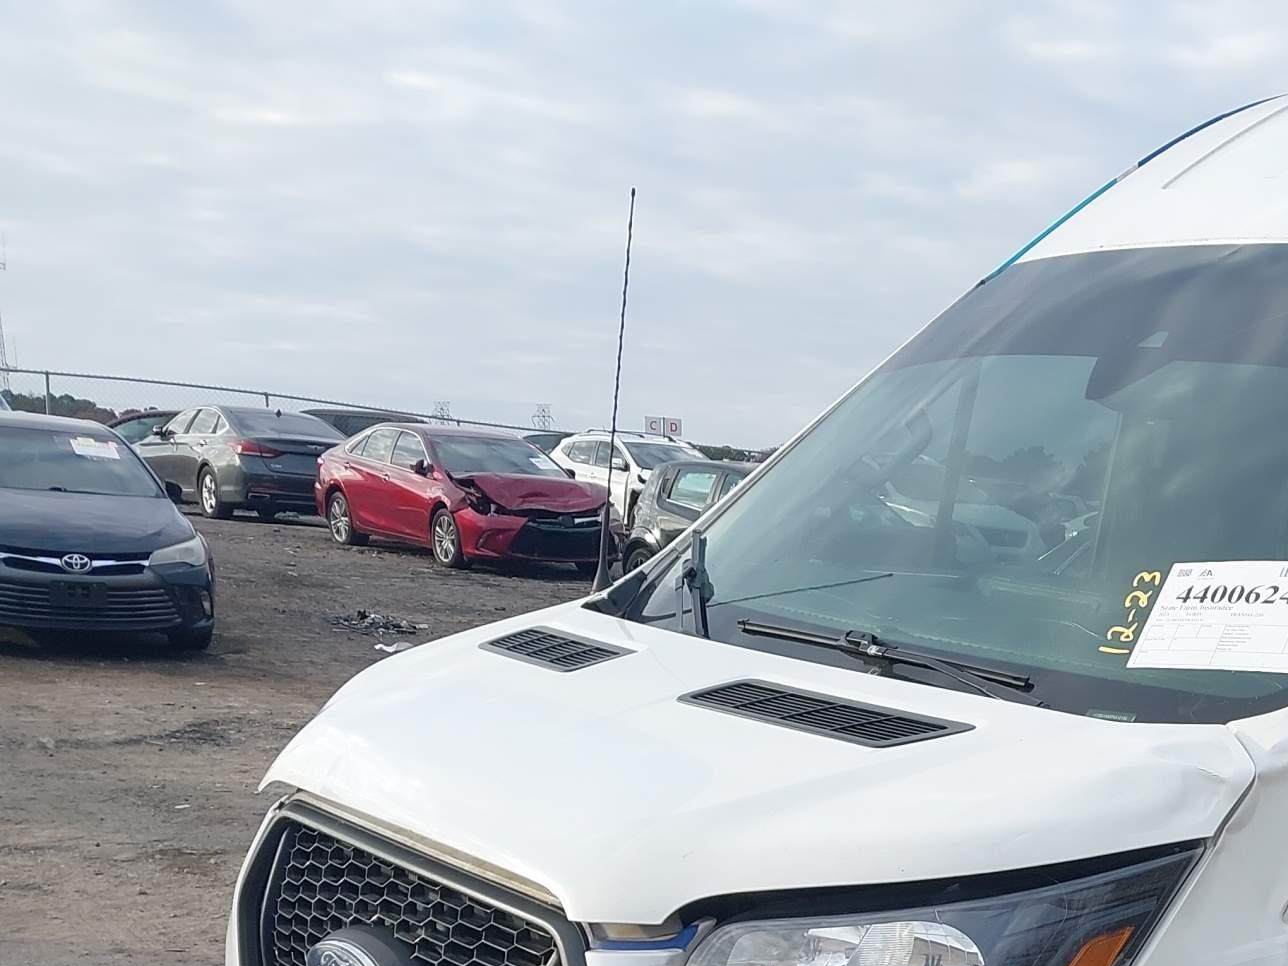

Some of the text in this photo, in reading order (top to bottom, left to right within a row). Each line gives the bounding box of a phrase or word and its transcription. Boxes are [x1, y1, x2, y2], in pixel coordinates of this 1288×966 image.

[650, 421, 657, 431] C
[670, 423, 678, 432] D
[1098, 571, 1161, 654] 12-23
